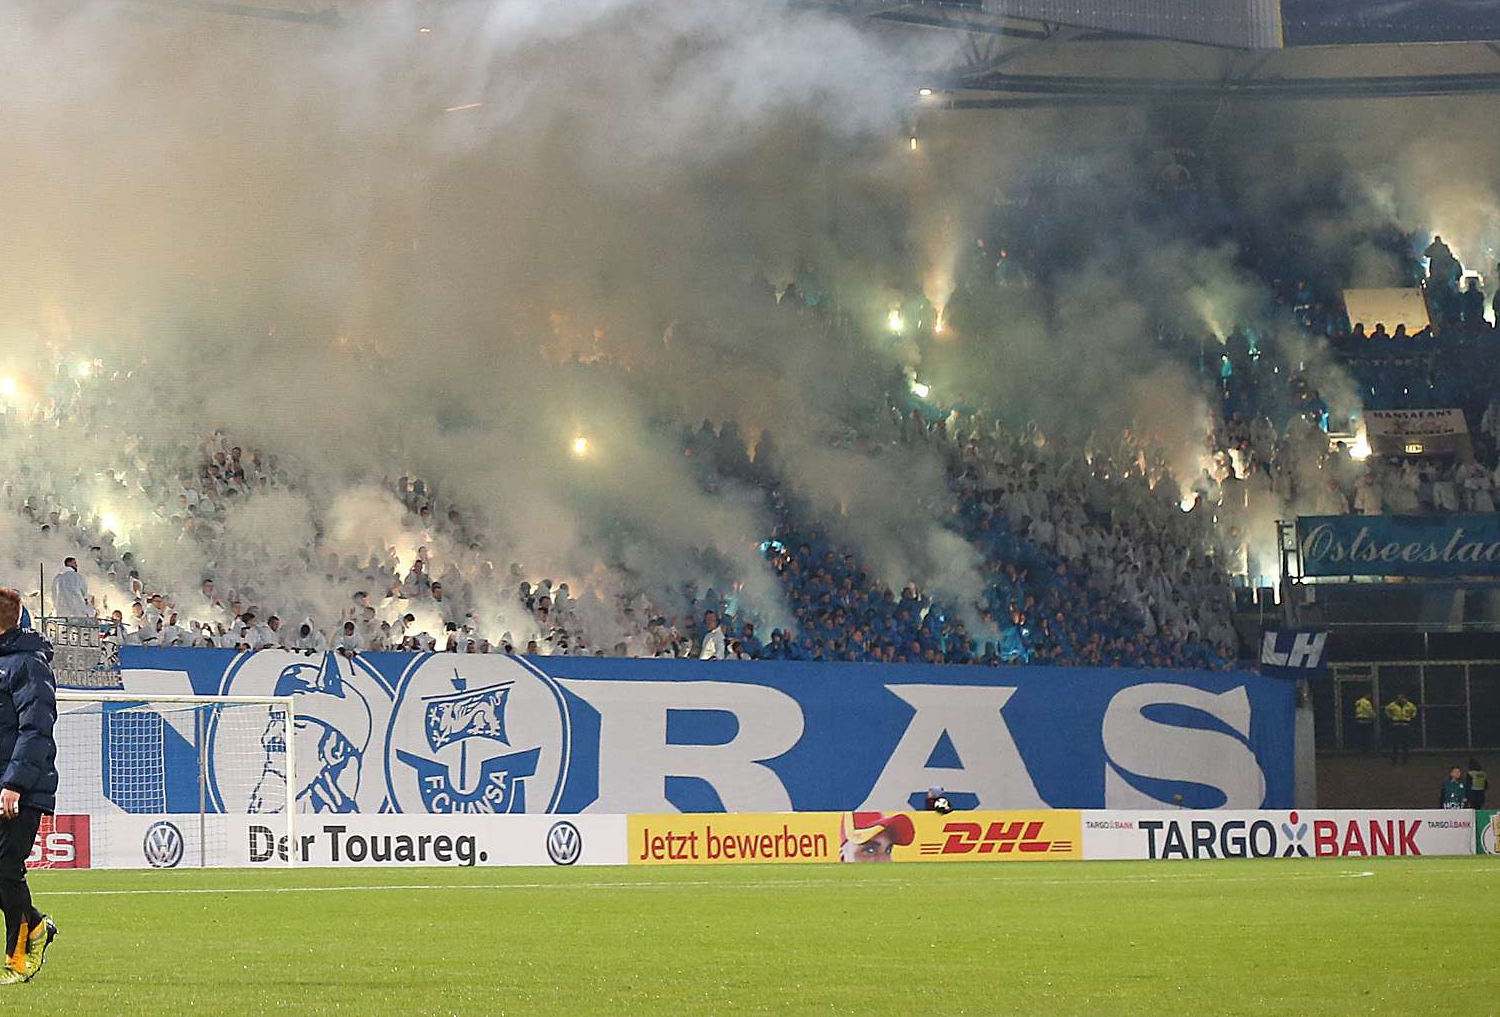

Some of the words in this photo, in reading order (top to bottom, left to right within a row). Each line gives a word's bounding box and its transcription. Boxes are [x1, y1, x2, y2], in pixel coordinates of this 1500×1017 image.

[1261, 630, 1328, 669] LH
[249, 825, 315, 863] Der
[323, 825, 488, 867] Touareg.
[640, 828, 699, 861] Jetzt
[706, 825, 828, 859] bewerben
[940, 821, 1054, 853] DHL
